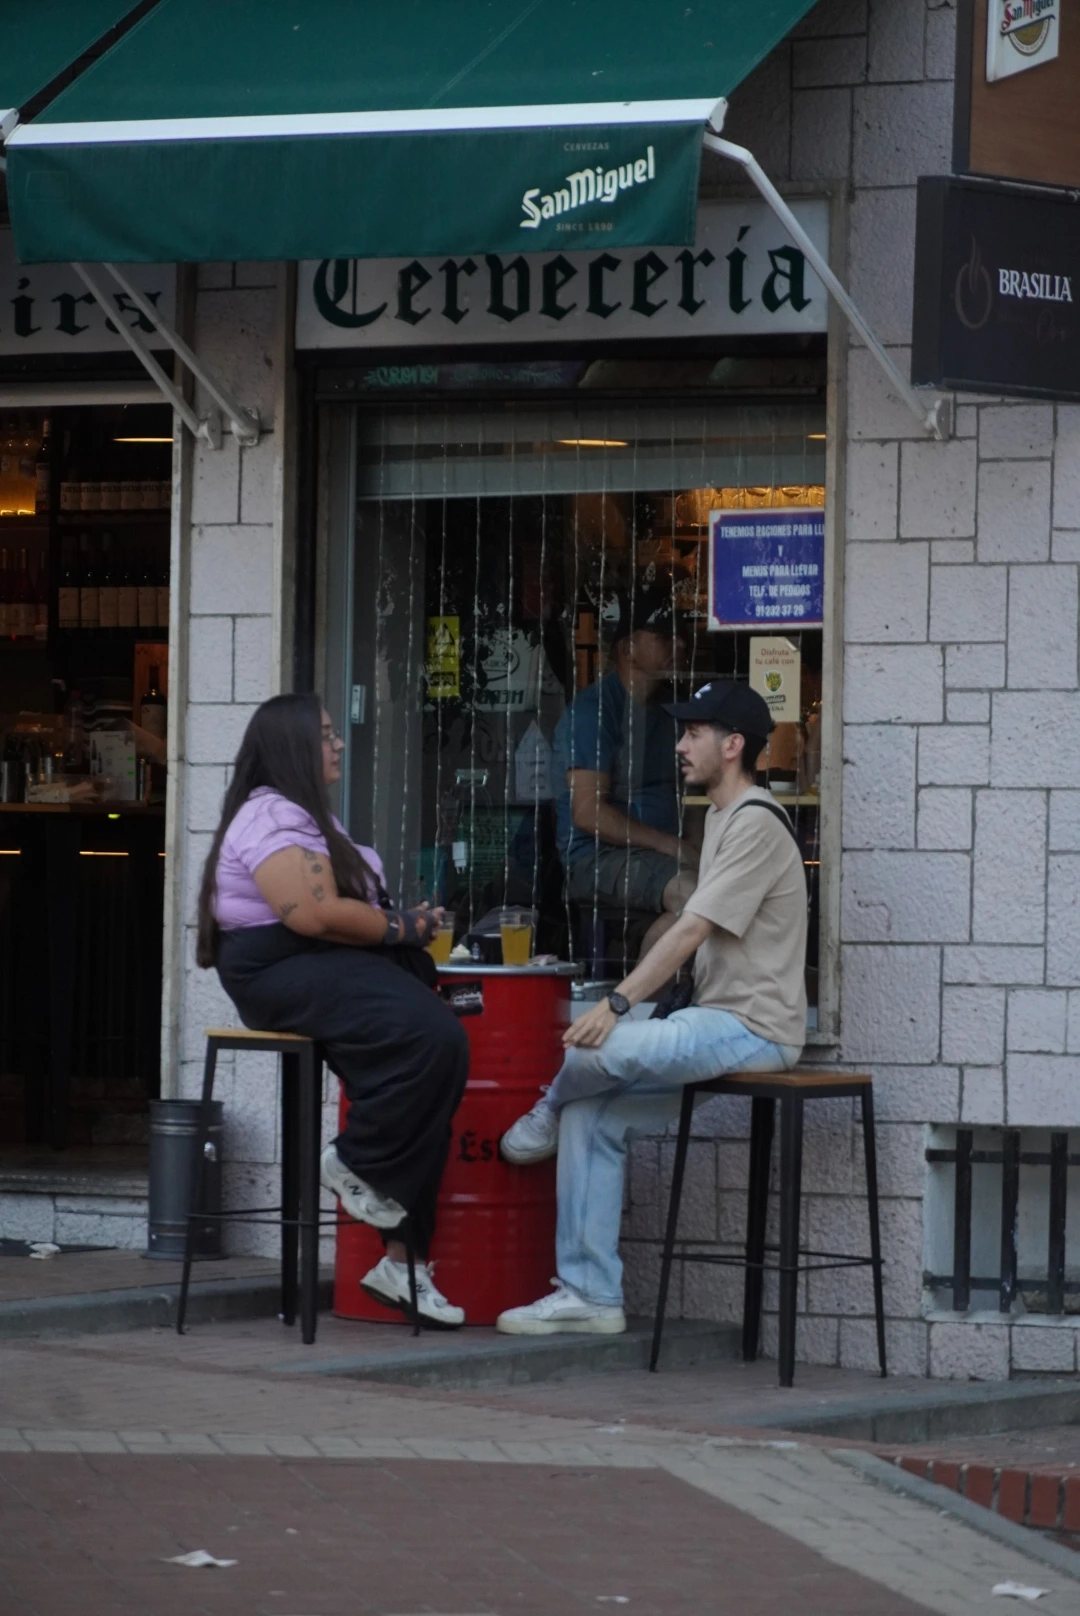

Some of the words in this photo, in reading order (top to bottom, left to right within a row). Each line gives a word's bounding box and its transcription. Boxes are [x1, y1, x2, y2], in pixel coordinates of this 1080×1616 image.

[563, 142, 610, 152] CERVEZAS
[556, 222, 584, 232] SINCE
[588, 222, 613, 232] 1890
[312, 226, 812, 329] Cervecería
[998, 268, 1073, 303] BRASILIA
[720, 525, 755, 539] TENEMOS
[756, 524, 792, 538] RACIONES
[793, 523, 813, 537] PARA
[777, 544, 784, 557] Y
[741, 564, 769, 578] MENUS
[769, 564, 790, 577] PARA
[790, 563, 819, 577] LLEVAR
[749, 584, 768, 598] TELF.
[768, 584, 779, 597] DE
[779, 584, 811, 597] PEDIDOS
[755, 604, 764, 617] 91
[764, 604, 781, 617] 232
[781, 604, 792, 616] 37
[760, 648, 790, 656] Disfruta
[764, 657, 780, 665] café
